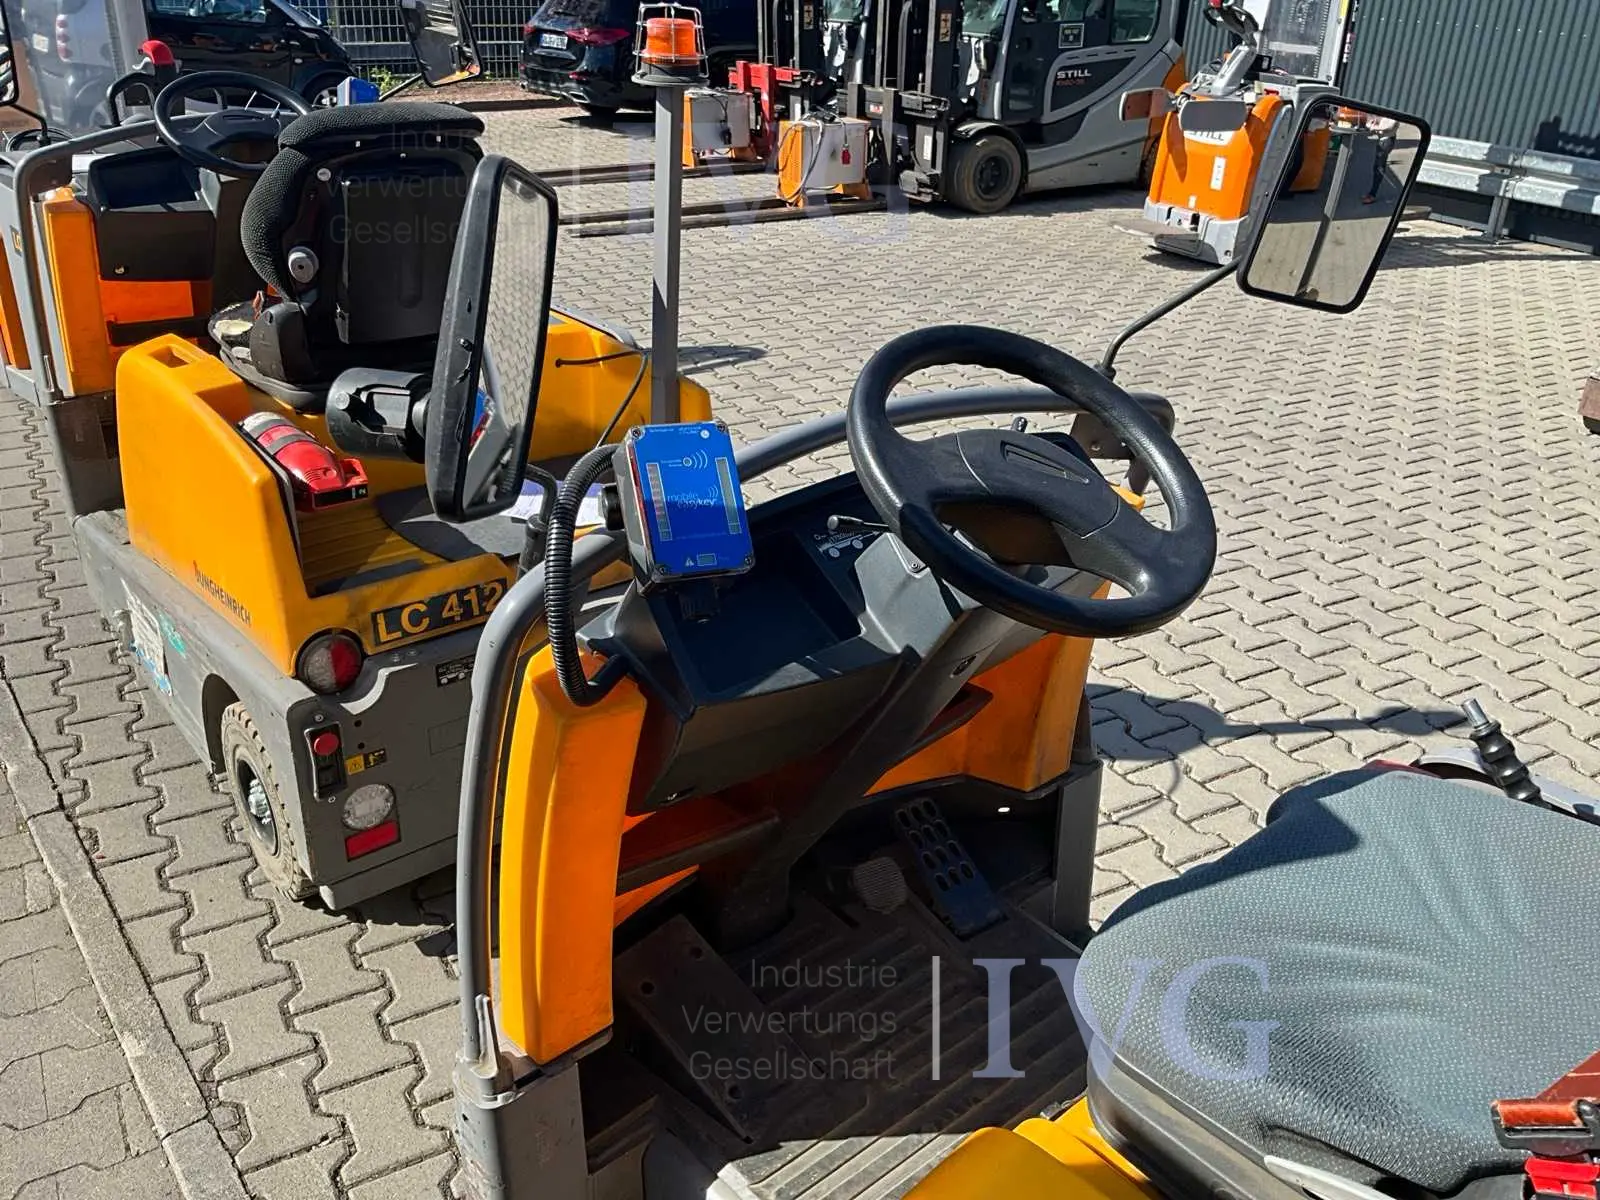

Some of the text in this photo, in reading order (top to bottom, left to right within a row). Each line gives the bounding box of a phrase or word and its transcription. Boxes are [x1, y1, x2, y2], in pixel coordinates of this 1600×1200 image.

[1056, 68, 1092, 79] STILL
[193, 560, 252, 626] JUNGHEINRICH
[376, 581, 503, 642] LC 412
